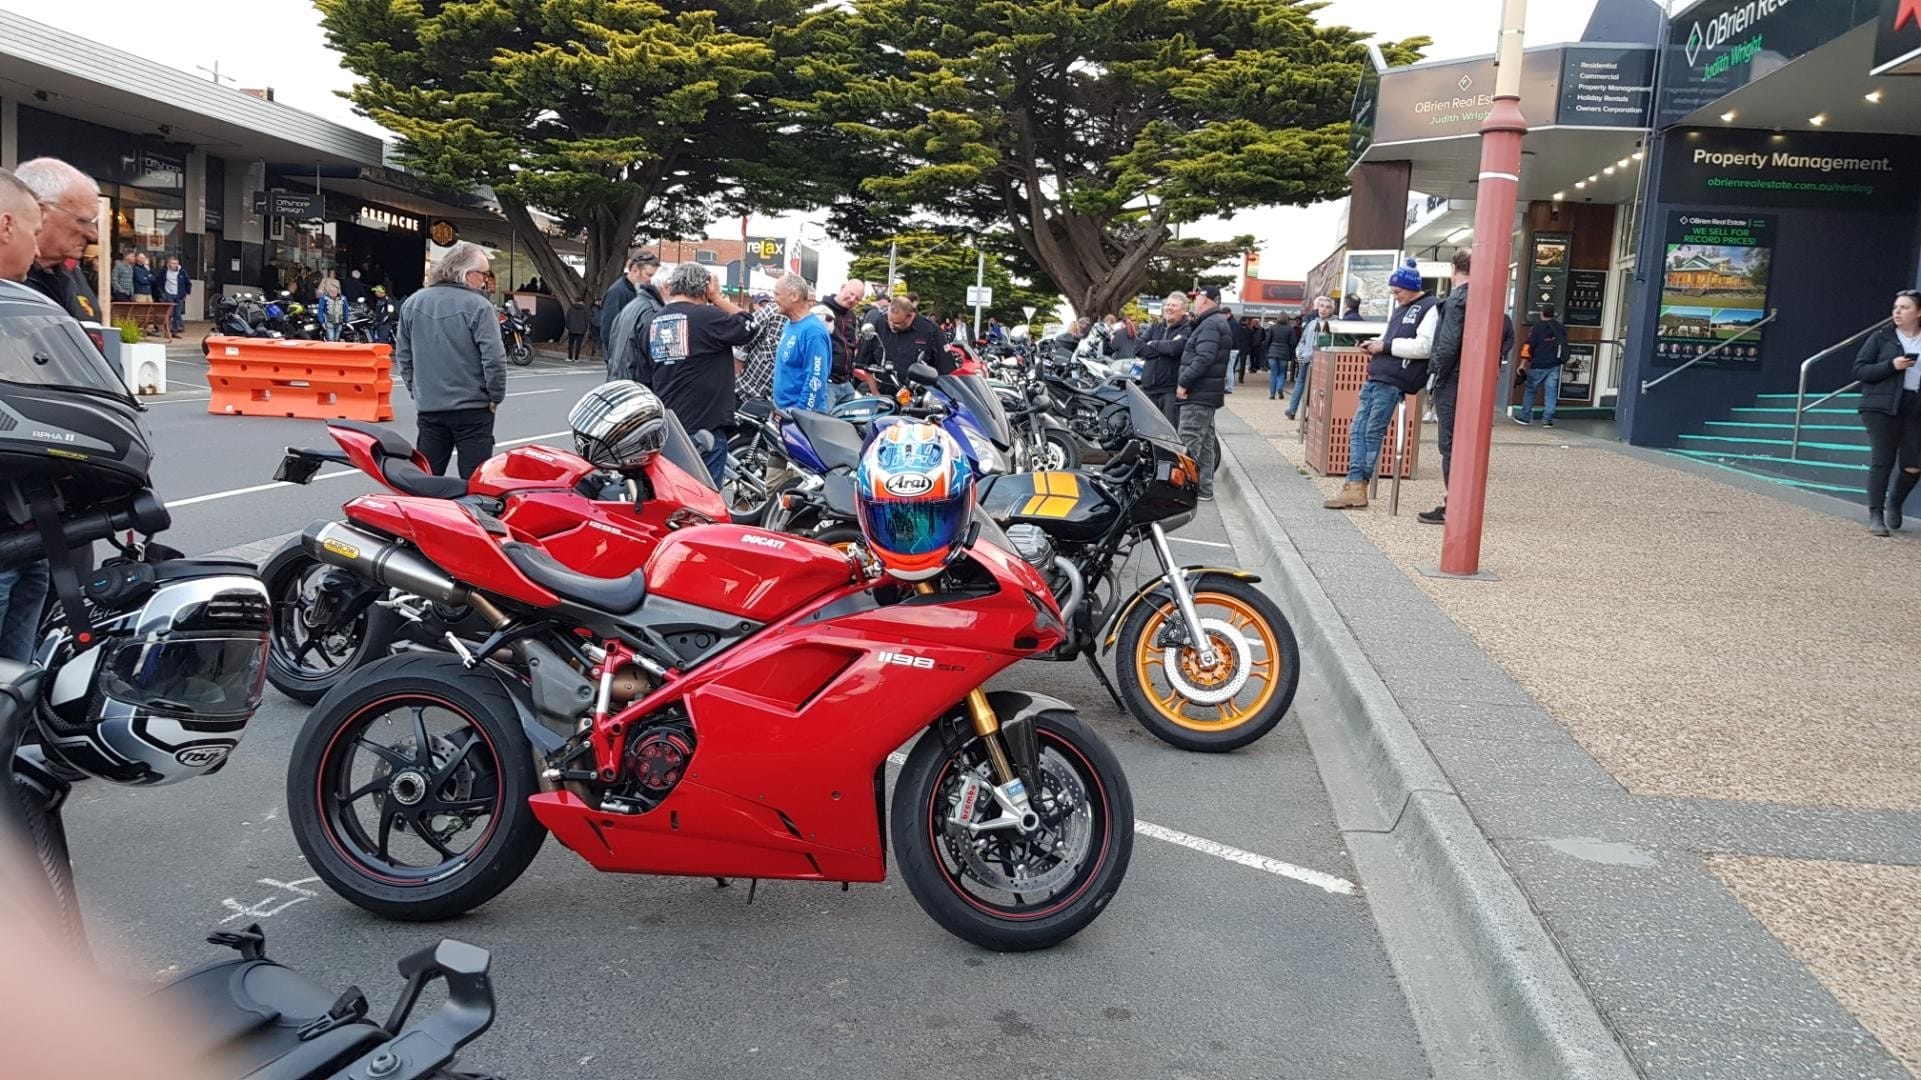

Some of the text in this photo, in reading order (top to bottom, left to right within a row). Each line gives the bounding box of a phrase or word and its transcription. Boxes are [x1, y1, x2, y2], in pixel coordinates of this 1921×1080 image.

[1705, 2, 1755, 50] OBrien
[1580, 62, 1618, 70] Residential
[1578, 84, 1607, 92] Property
[1415, 94, 1495, 113] OBrien Real Est
[1602, 106, 1643, 114] Corporation
[1430, 114, 1459, 125] Judith
[1693, 149, 1893, 172] Property Management.
[276, 199, 311, 208] Offshore
[361, 206, 419, 232] GRENACHE
[1692, 227, 1750, 237] WE SELL FOR
[1684, 235, 1721, 244] RECORD
[32, 430, 63, 440] RPHA
[888, 475, 926, 489] Arai
[740, 533, 787, 550] DUCATI
[878, 650, 936, 670] 1198
[960, 784, 977, 821] brembo
